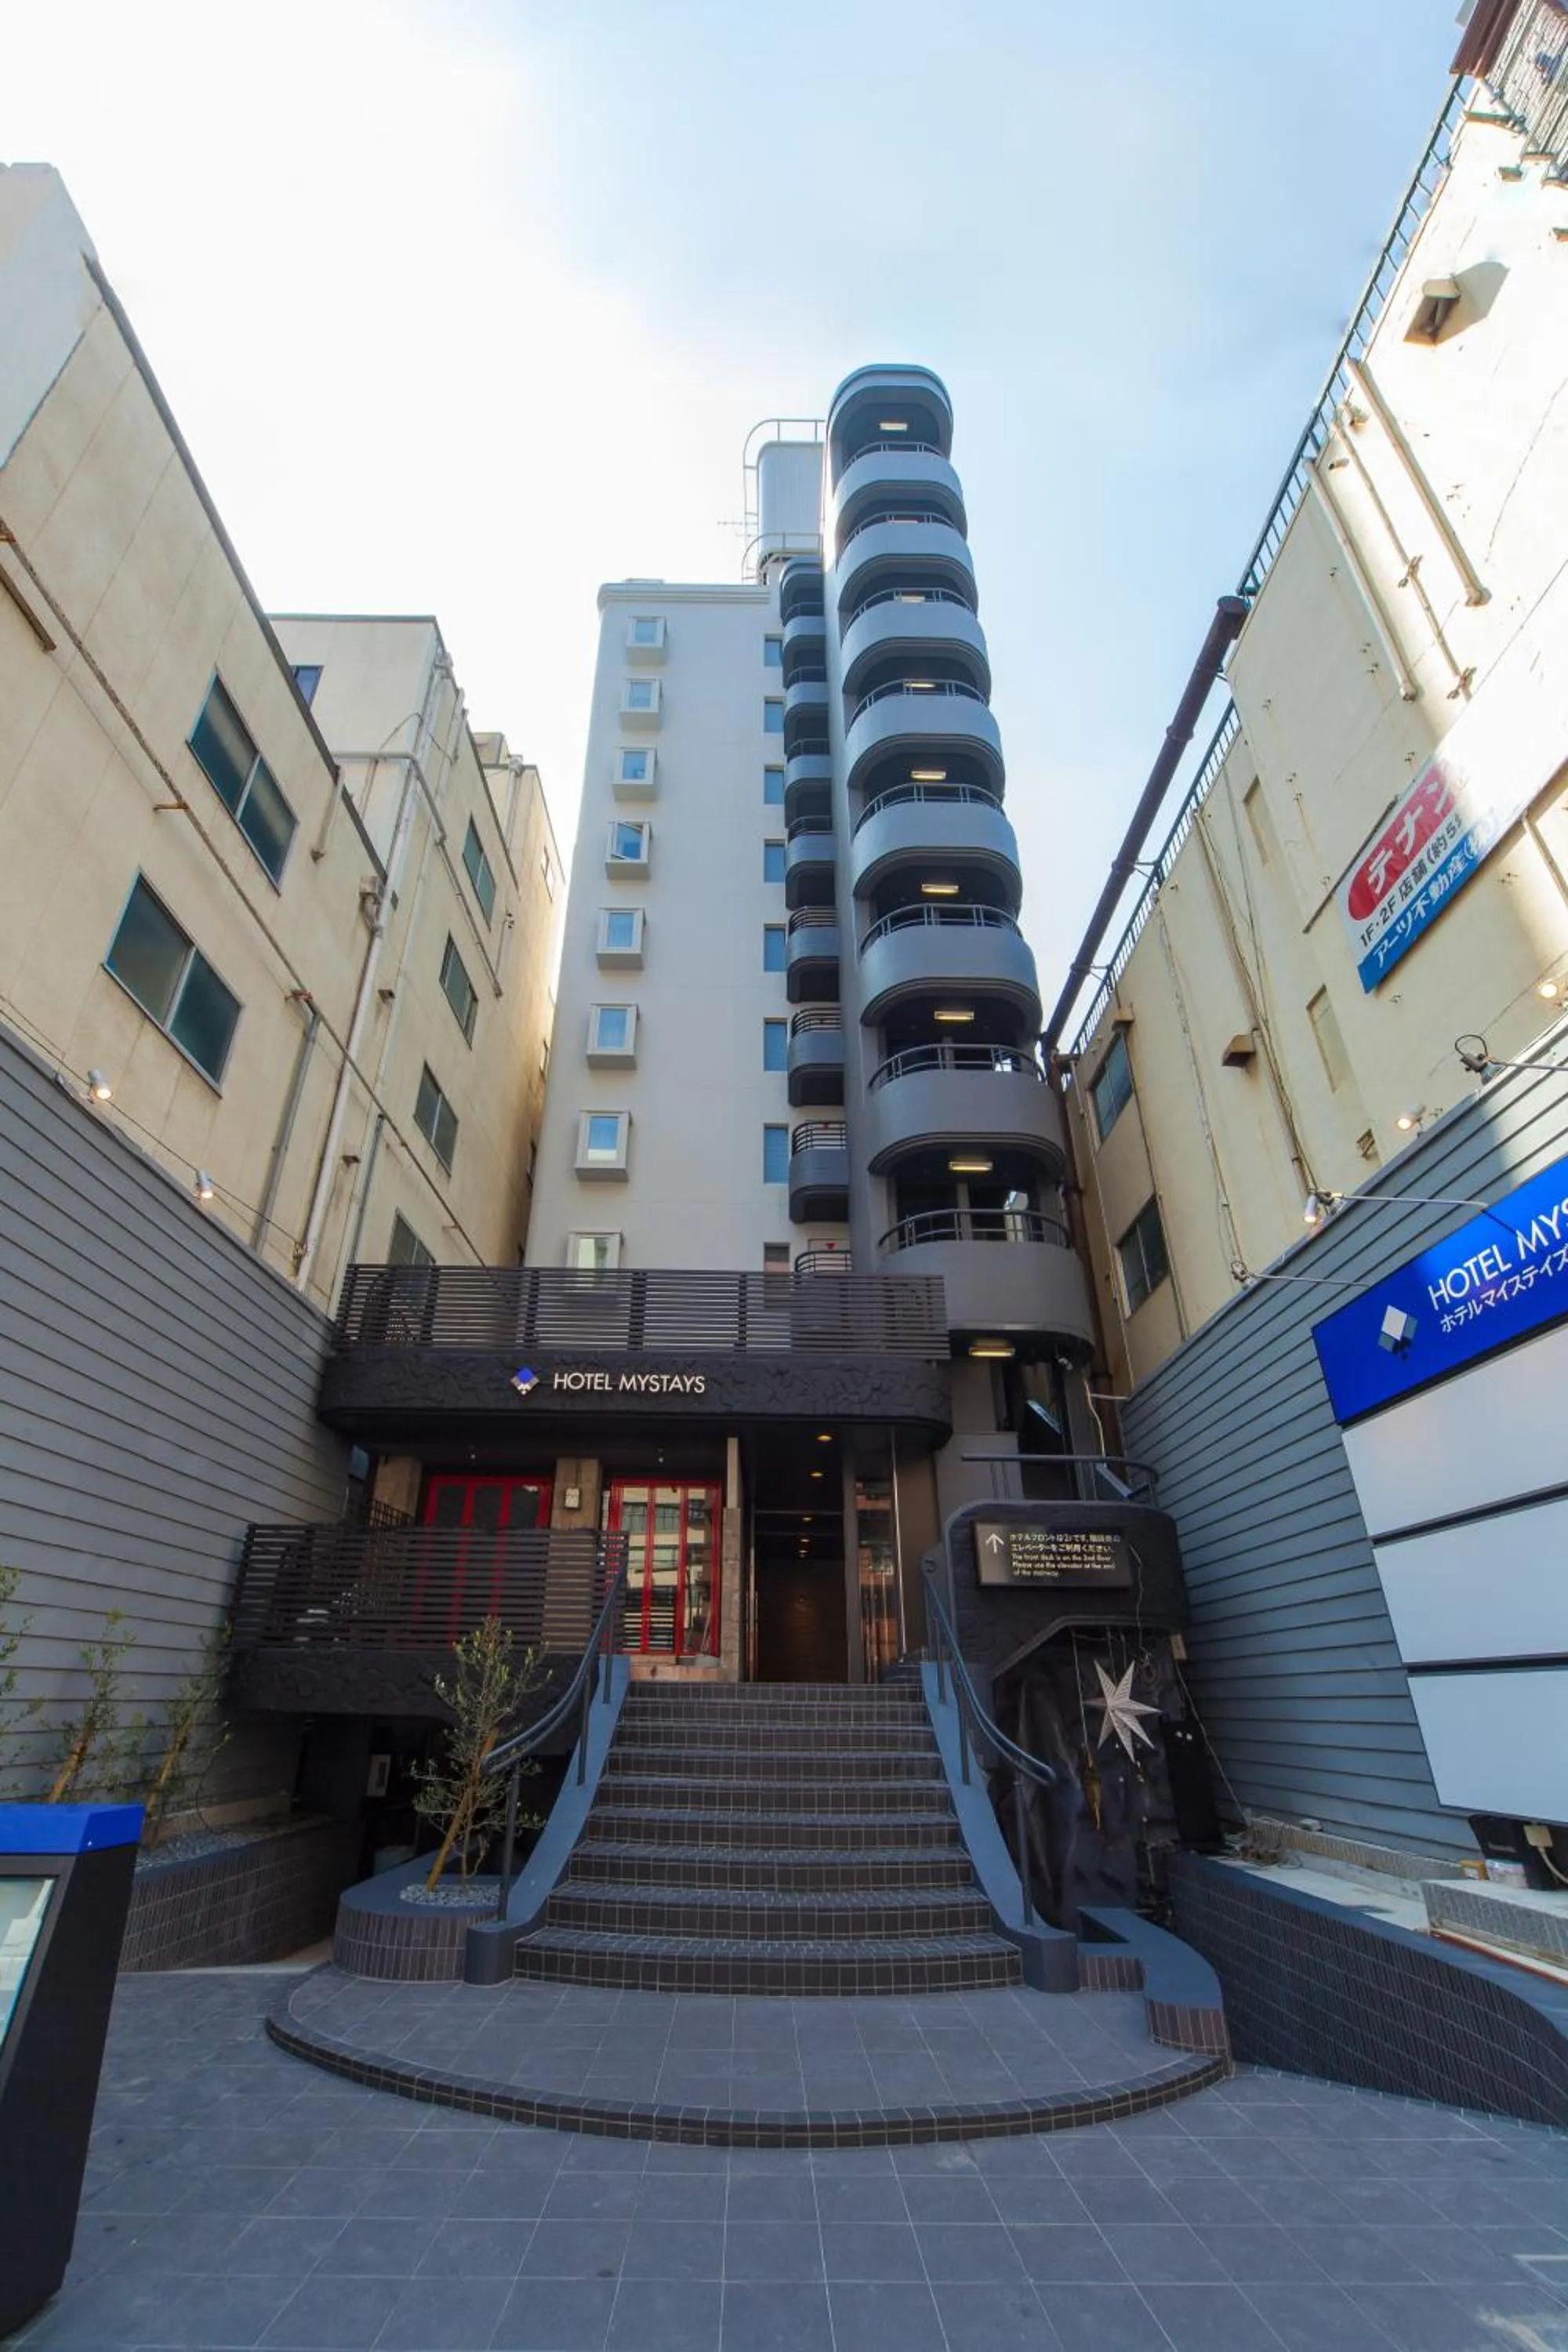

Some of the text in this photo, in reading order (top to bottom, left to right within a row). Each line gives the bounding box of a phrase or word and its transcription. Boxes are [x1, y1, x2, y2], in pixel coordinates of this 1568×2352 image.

[1428, 1244, 1512, 1311] HOTEL
[554, 1373, 705, 1393] HOTEL MYSTAYS
